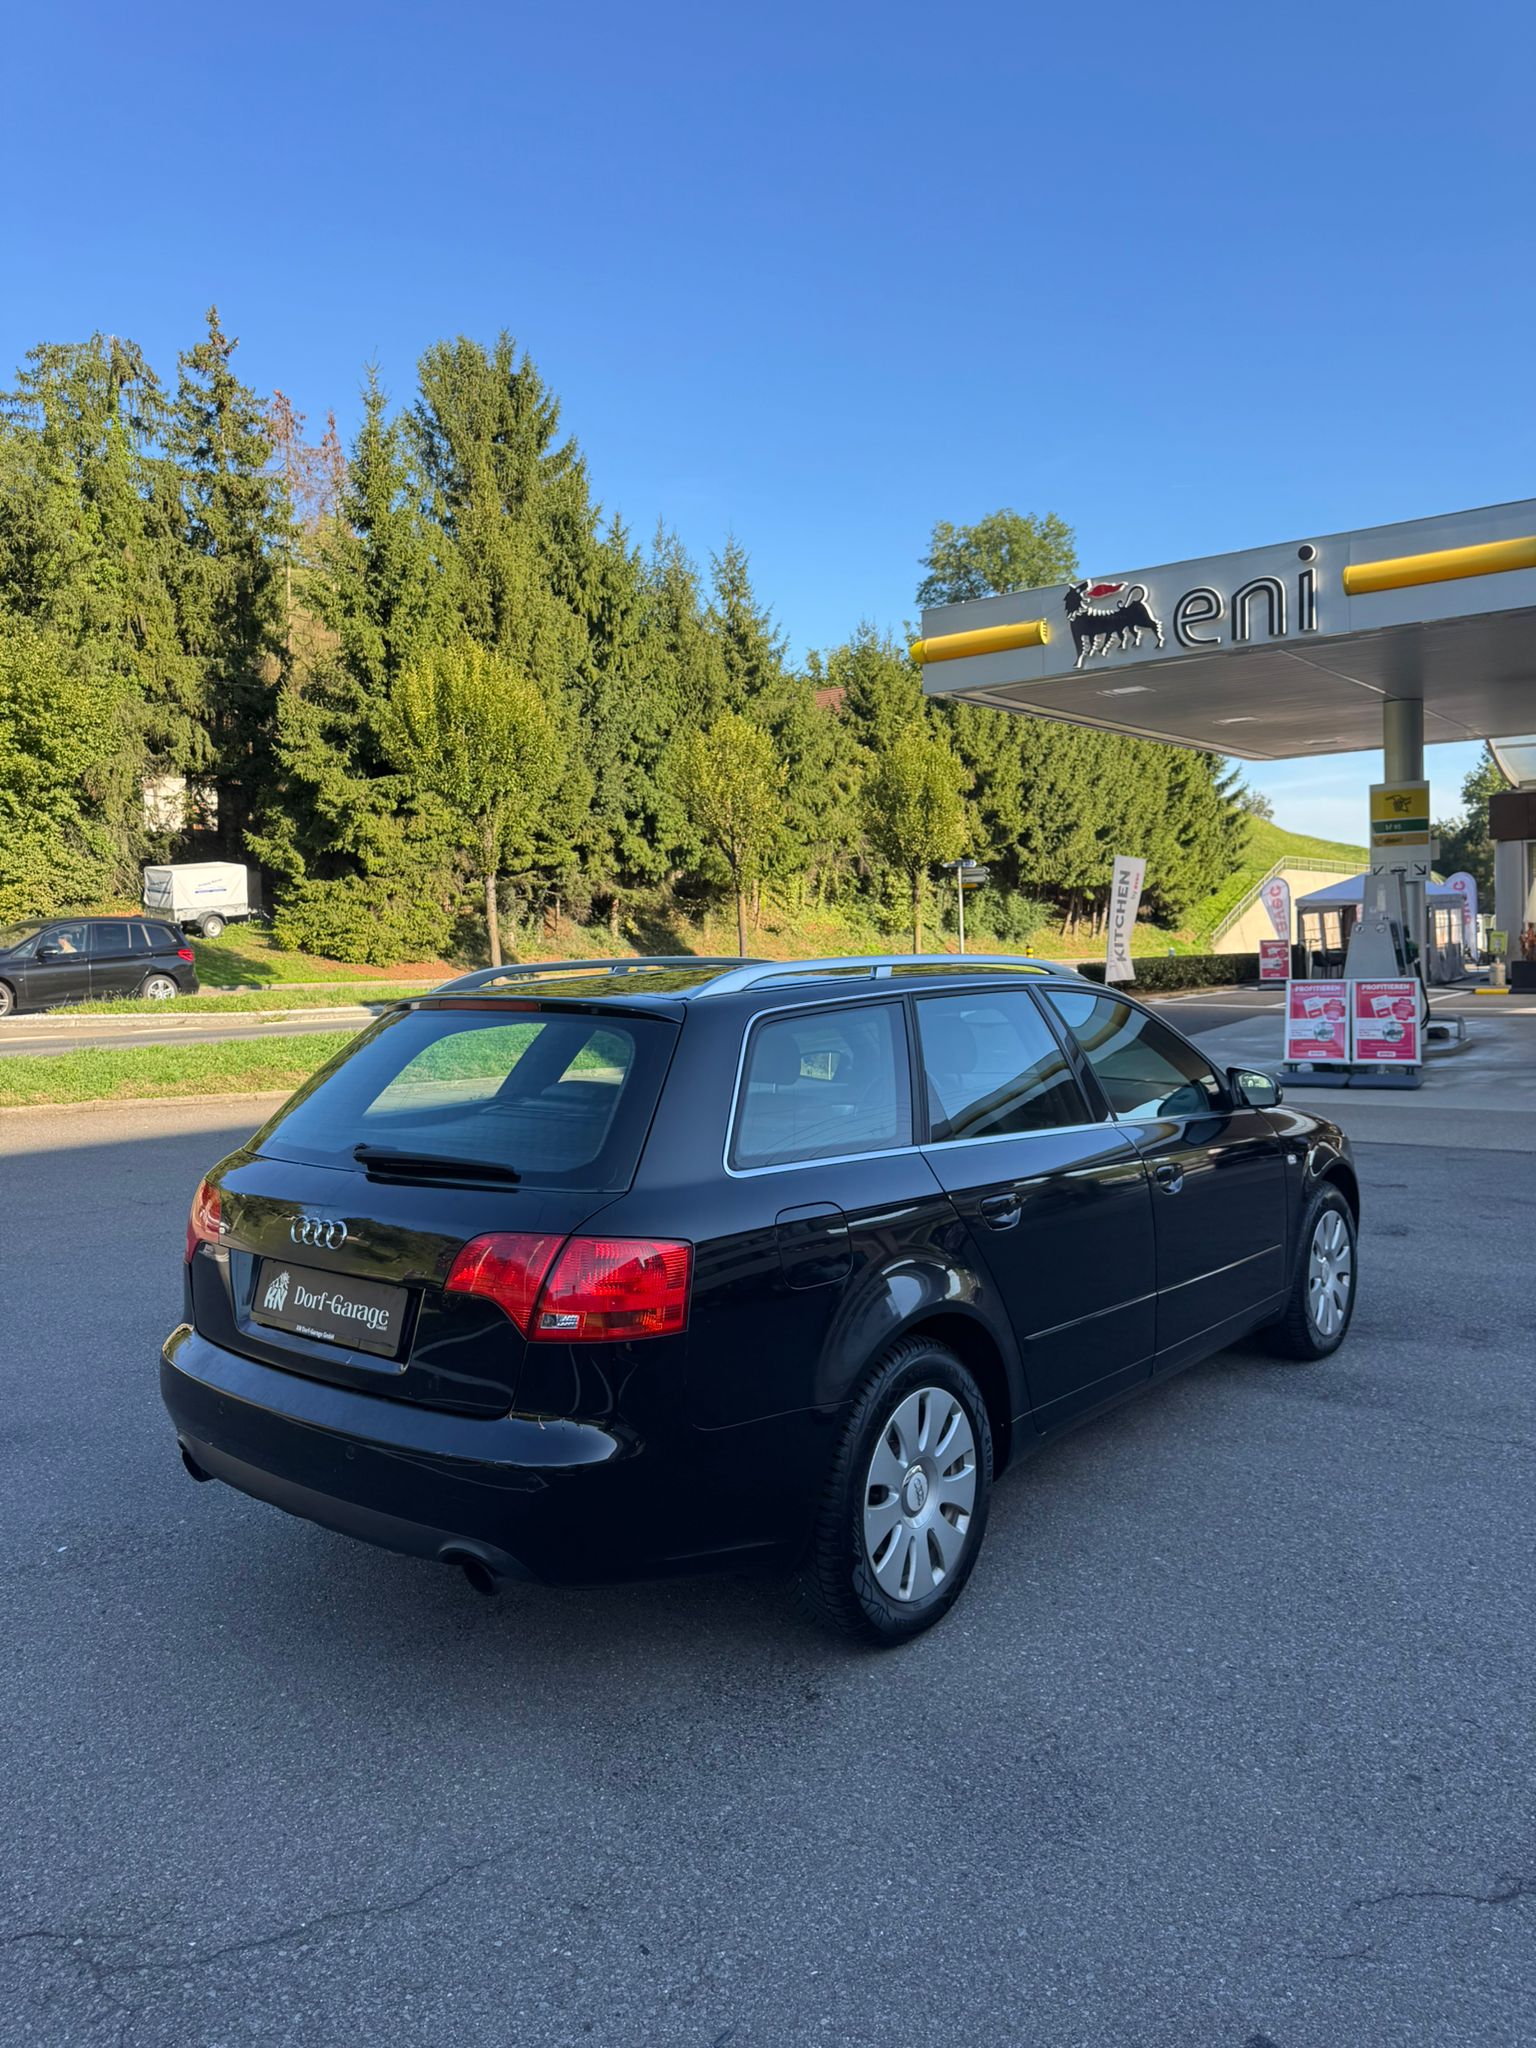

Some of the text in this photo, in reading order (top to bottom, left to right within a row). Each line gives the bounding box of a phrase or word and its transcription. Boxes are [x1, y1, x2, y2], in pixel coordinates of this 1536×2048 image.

[1173, 543, 1318, 648] eni
[1114, 870, 1131, 962] KITCHEN
[1361, 983, 1410, 991] PROFITIEREN
[293, 1285, 390, 1330] Dorf-Garage
